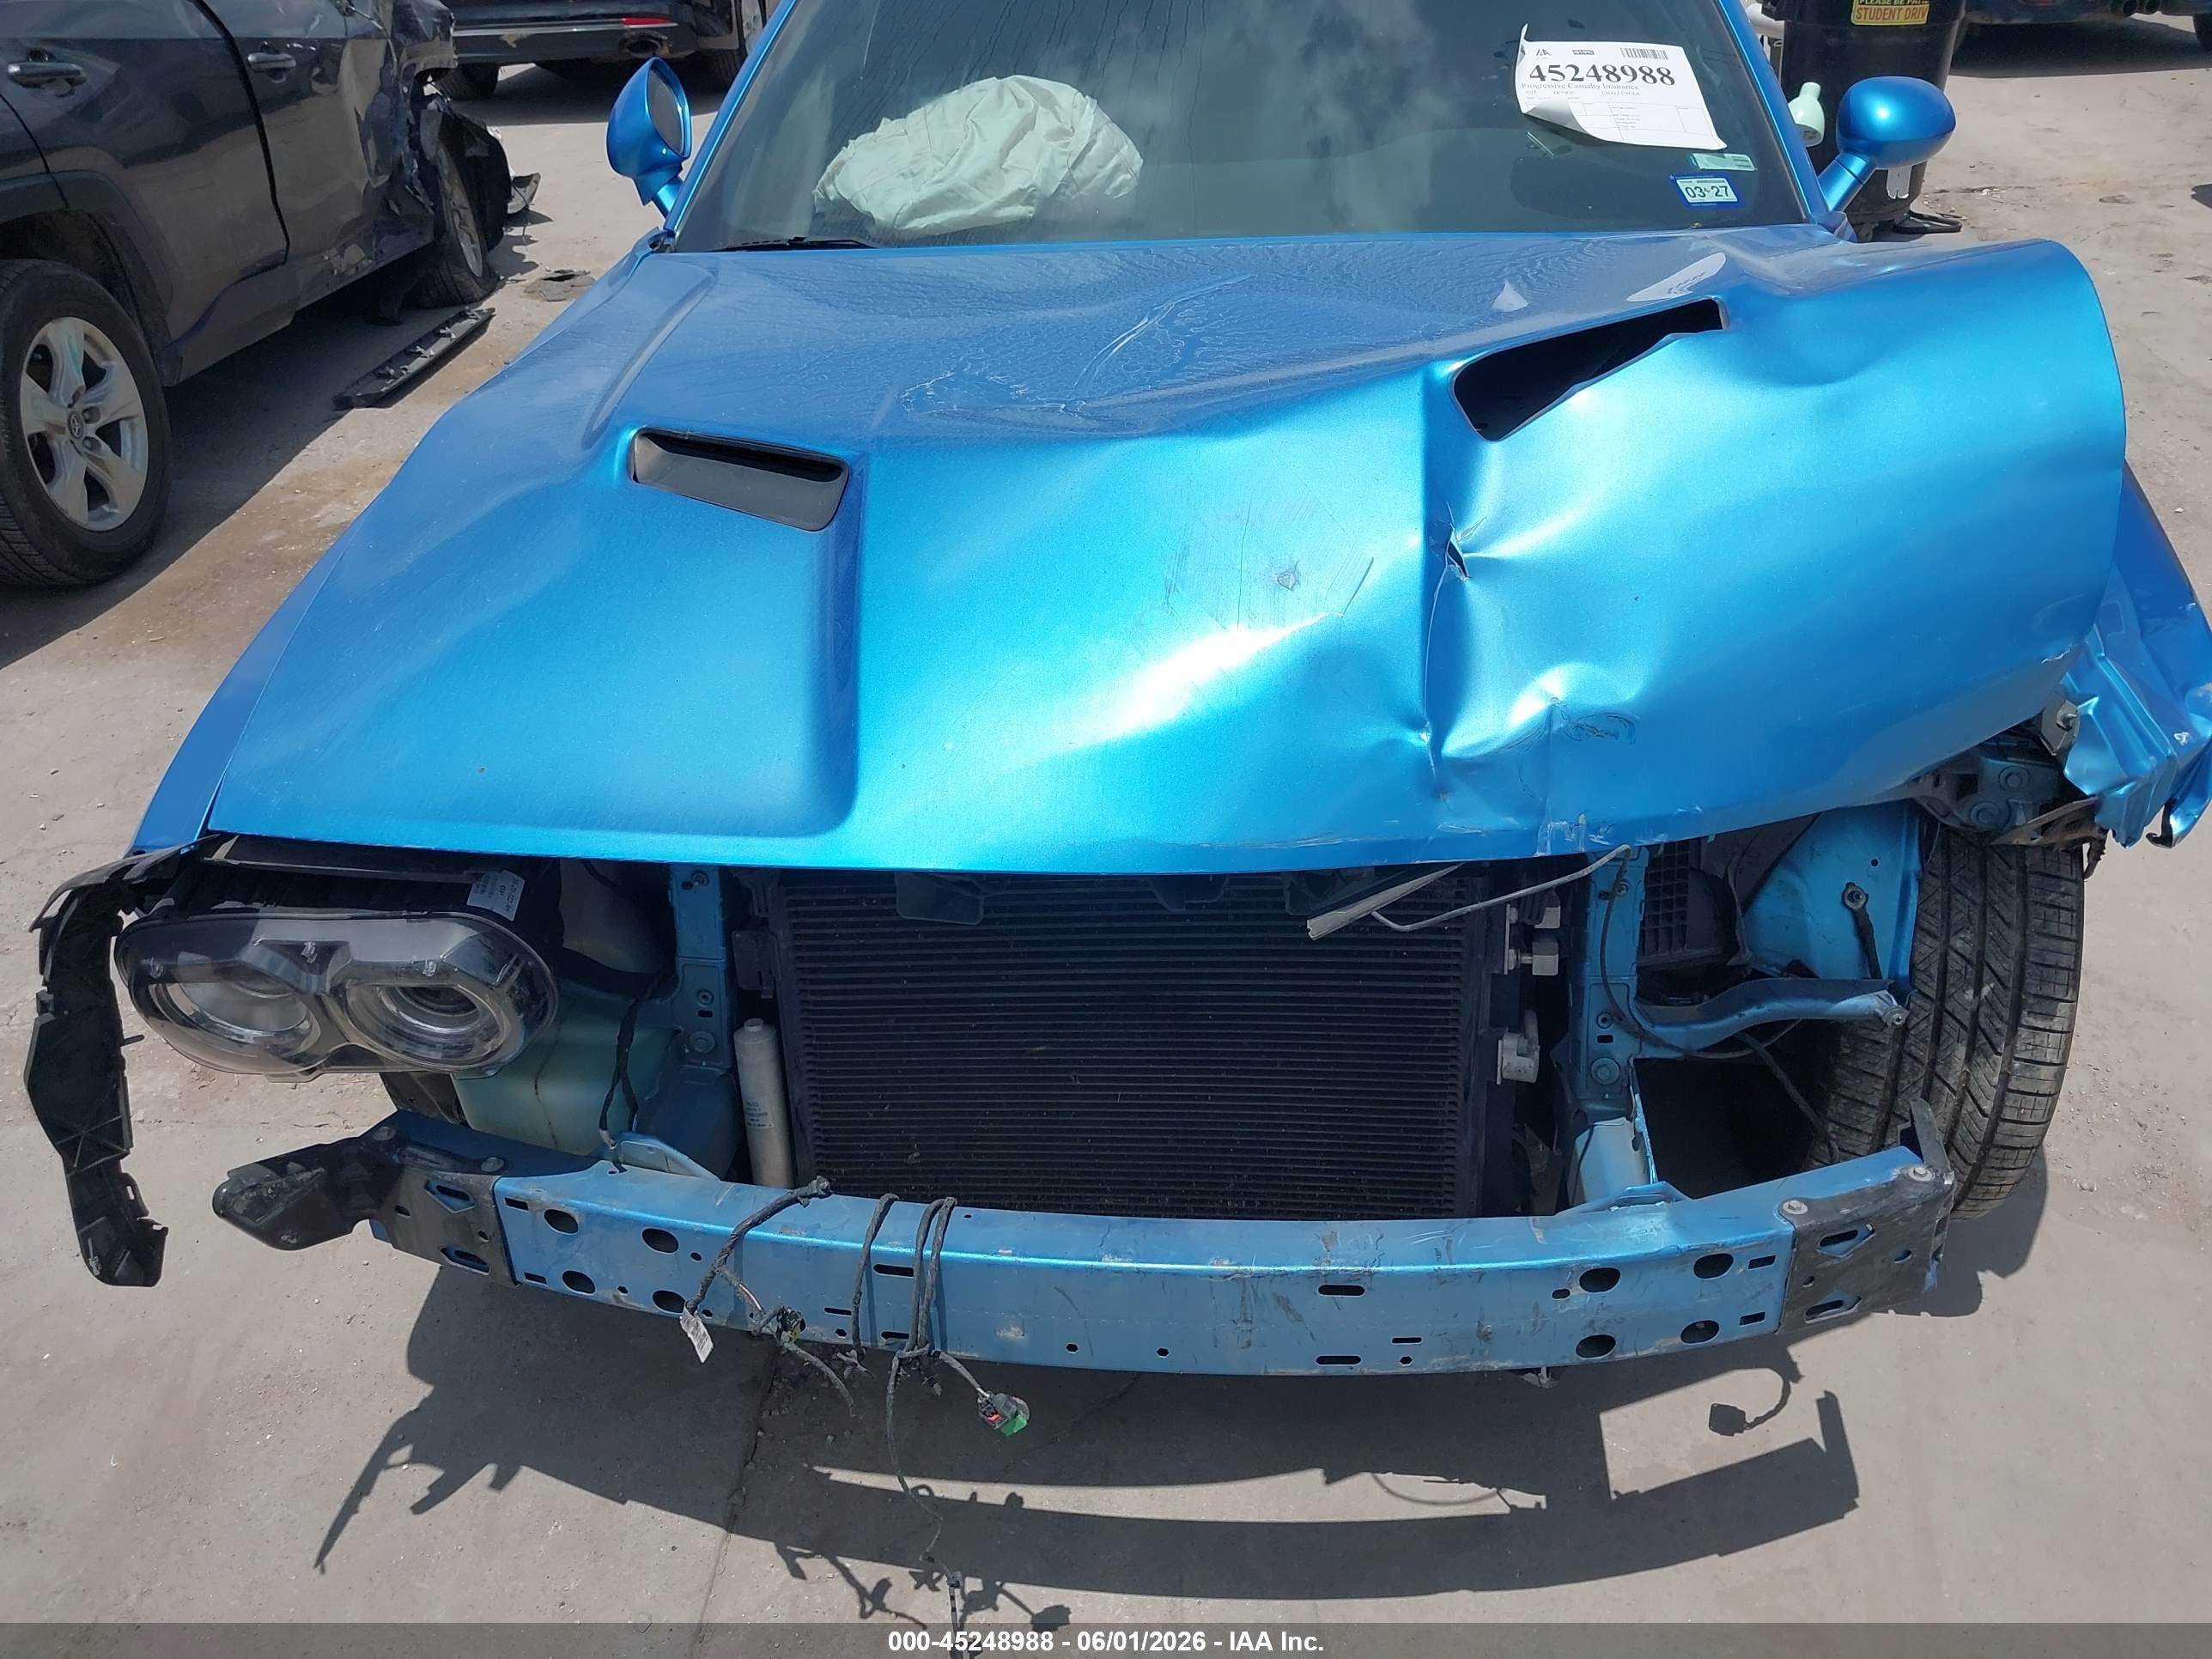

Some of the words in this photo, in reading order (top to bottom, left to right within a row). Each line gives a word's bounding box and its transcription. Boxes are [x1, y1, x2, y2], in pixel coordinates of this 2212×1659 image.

[1856, 6, 1903, 21] STUDENT
[1529, 64, 1676, 86] 45248988
[1567, 82, 1601, 91] Casualty
[1684, 185, 1706, 198] 03
[1711, 185, 1729, 198] 27
